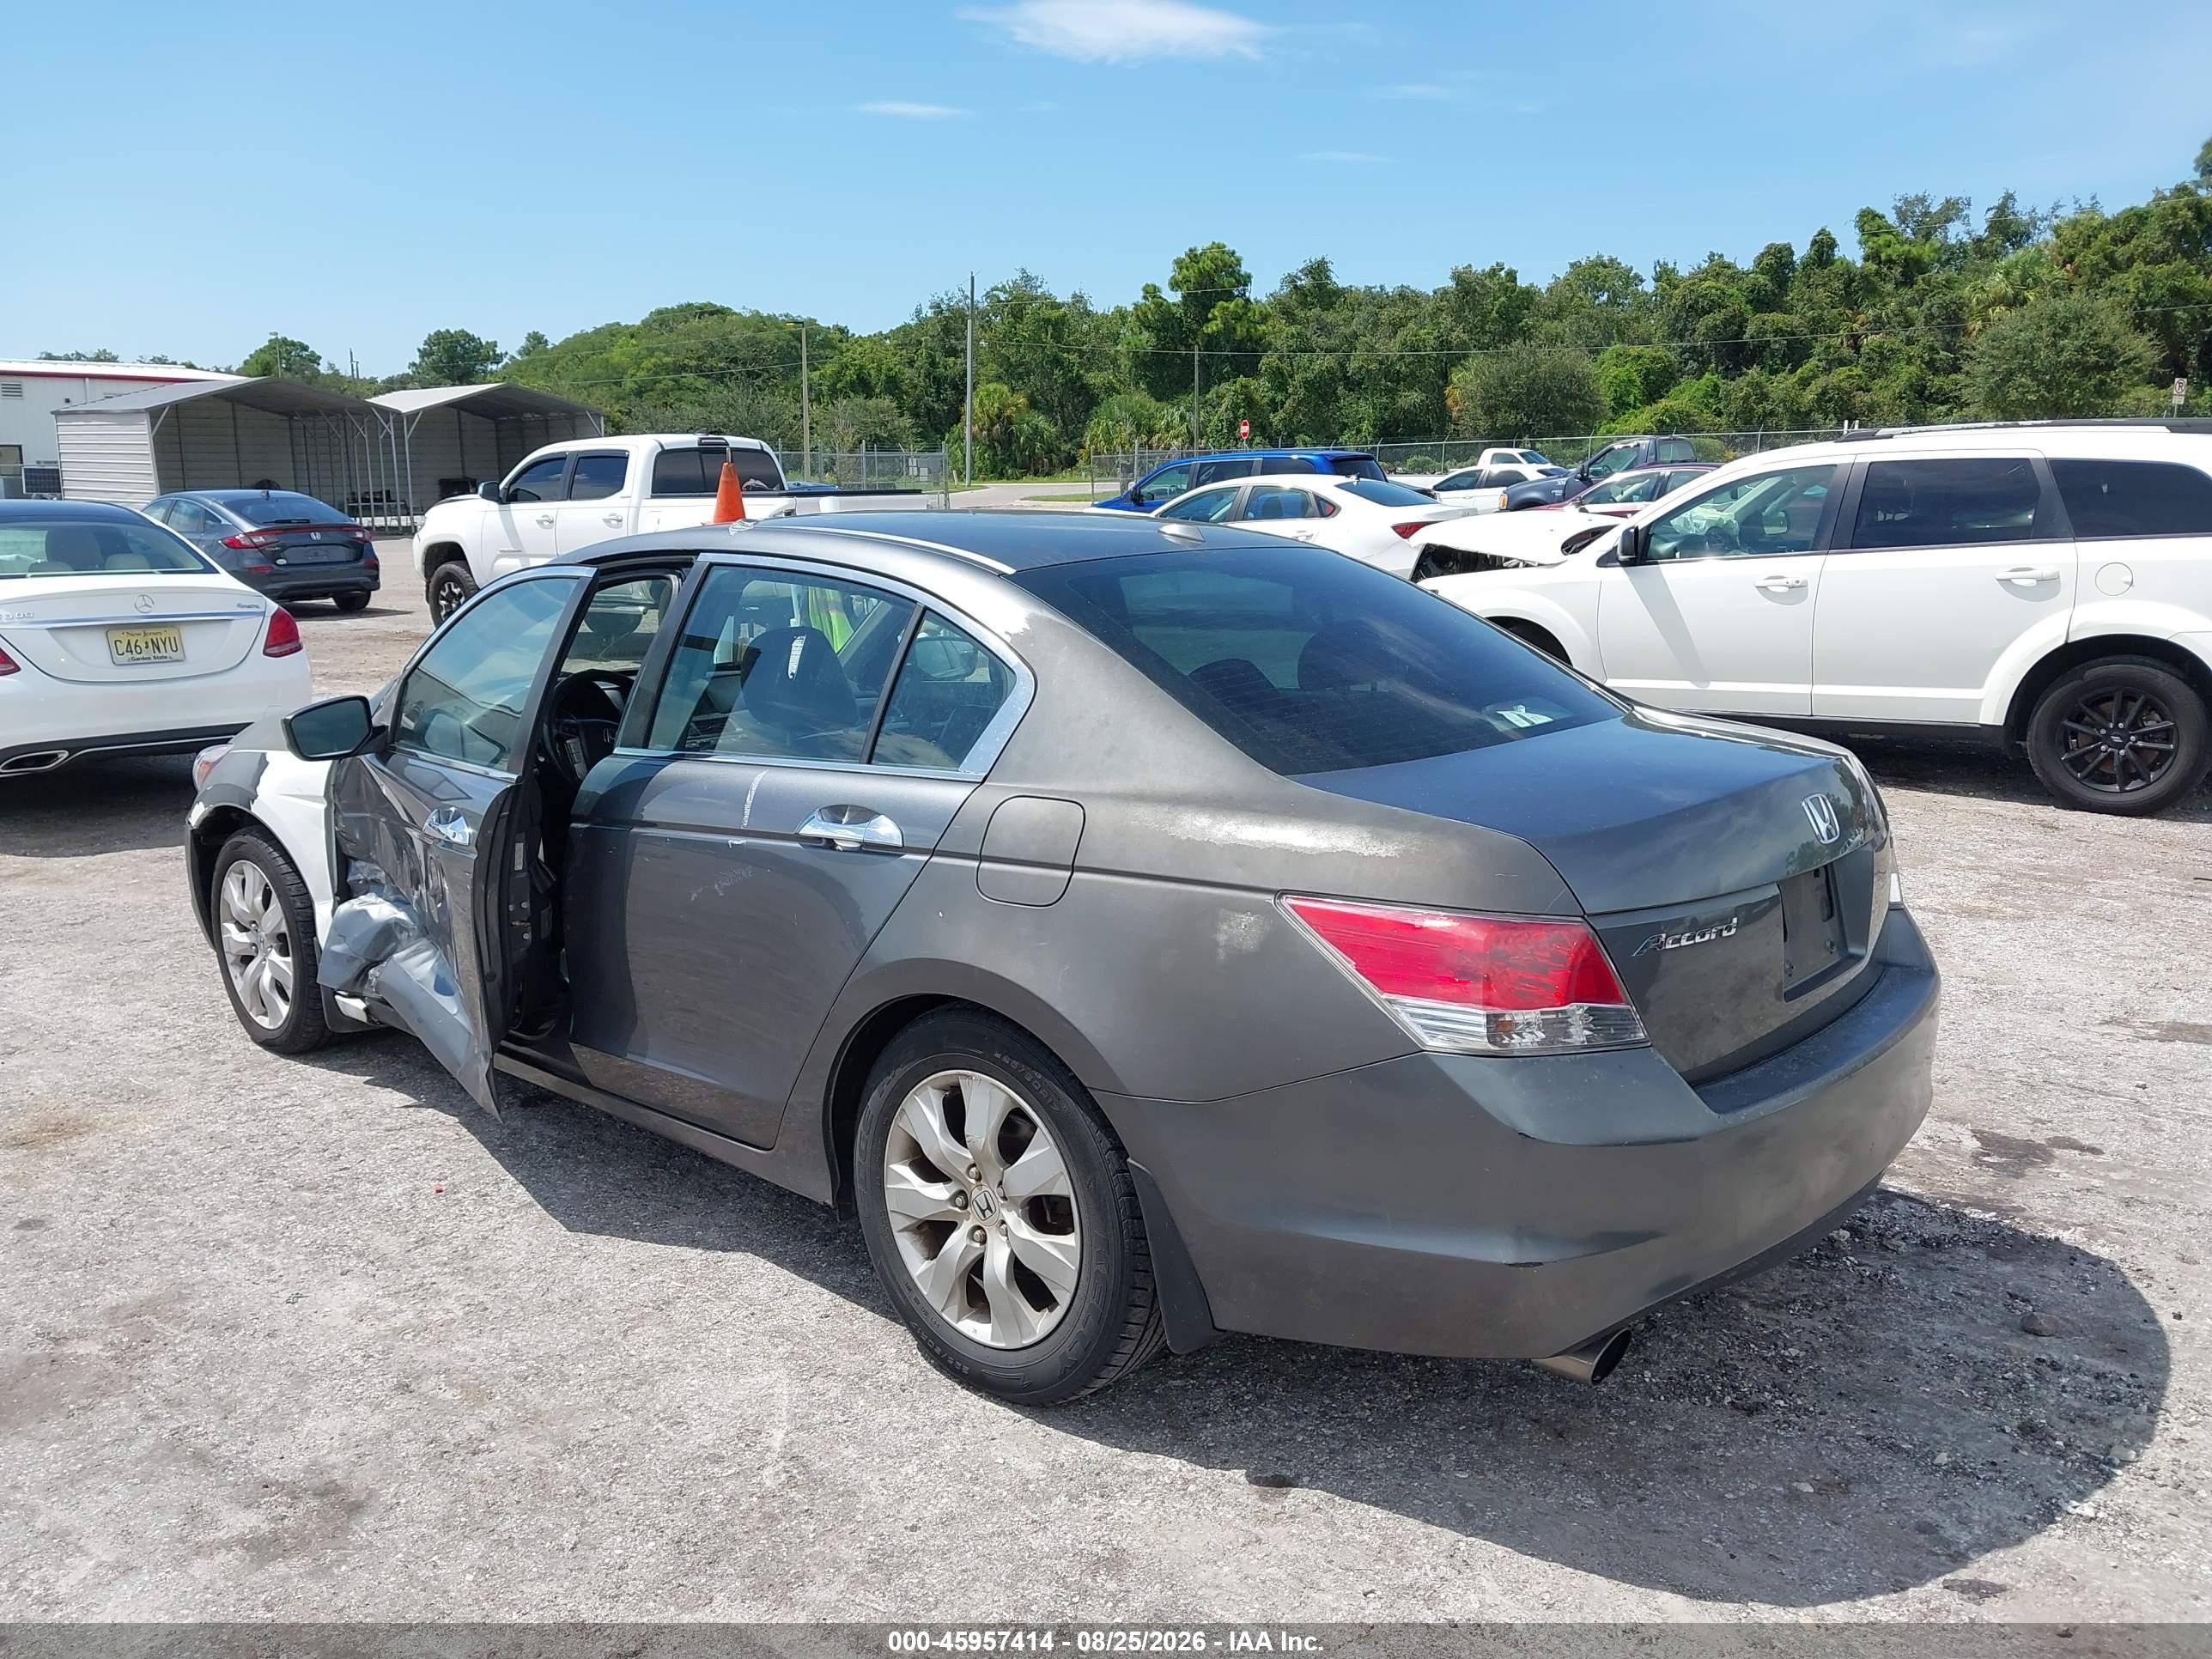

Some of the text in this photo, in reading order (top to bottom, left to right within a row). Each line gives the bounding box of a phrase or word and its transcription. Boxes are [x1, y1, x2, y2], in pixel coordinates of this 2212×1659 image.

[113, 636, 179, 656] C46 NYU
[1632, 916, 1738, 957] Accord
